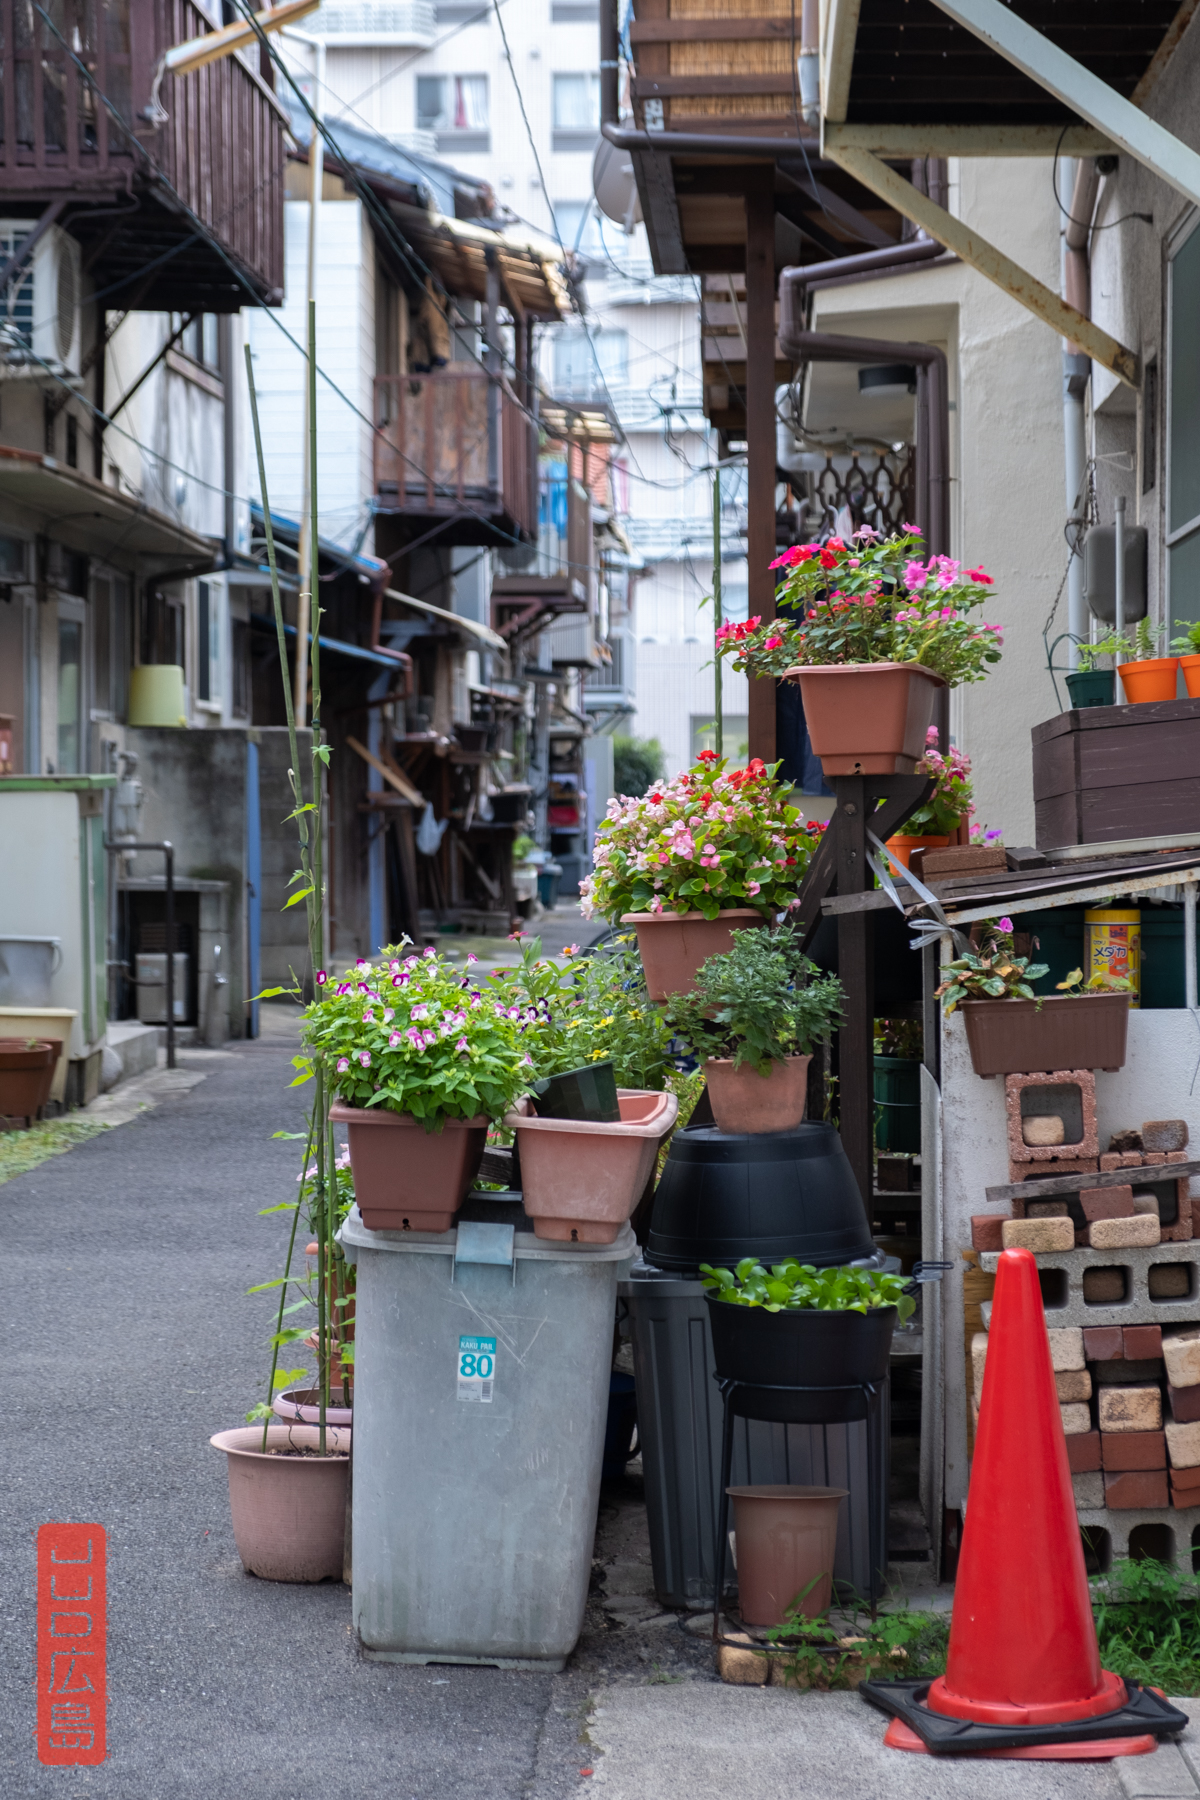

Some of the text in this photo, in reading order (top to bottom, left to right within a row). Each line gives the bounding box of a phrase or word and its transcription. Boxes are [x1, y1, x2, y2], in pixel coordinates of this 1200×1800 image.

[1093, 945, 1127, 958] メダカ
[1093, 958, 1115, 966] フレーク
[460, 1341, 478, 1350] KAKU
[480, 1342, 494, 1351] PAIL
[460, 1353, 493, 1378] 80
